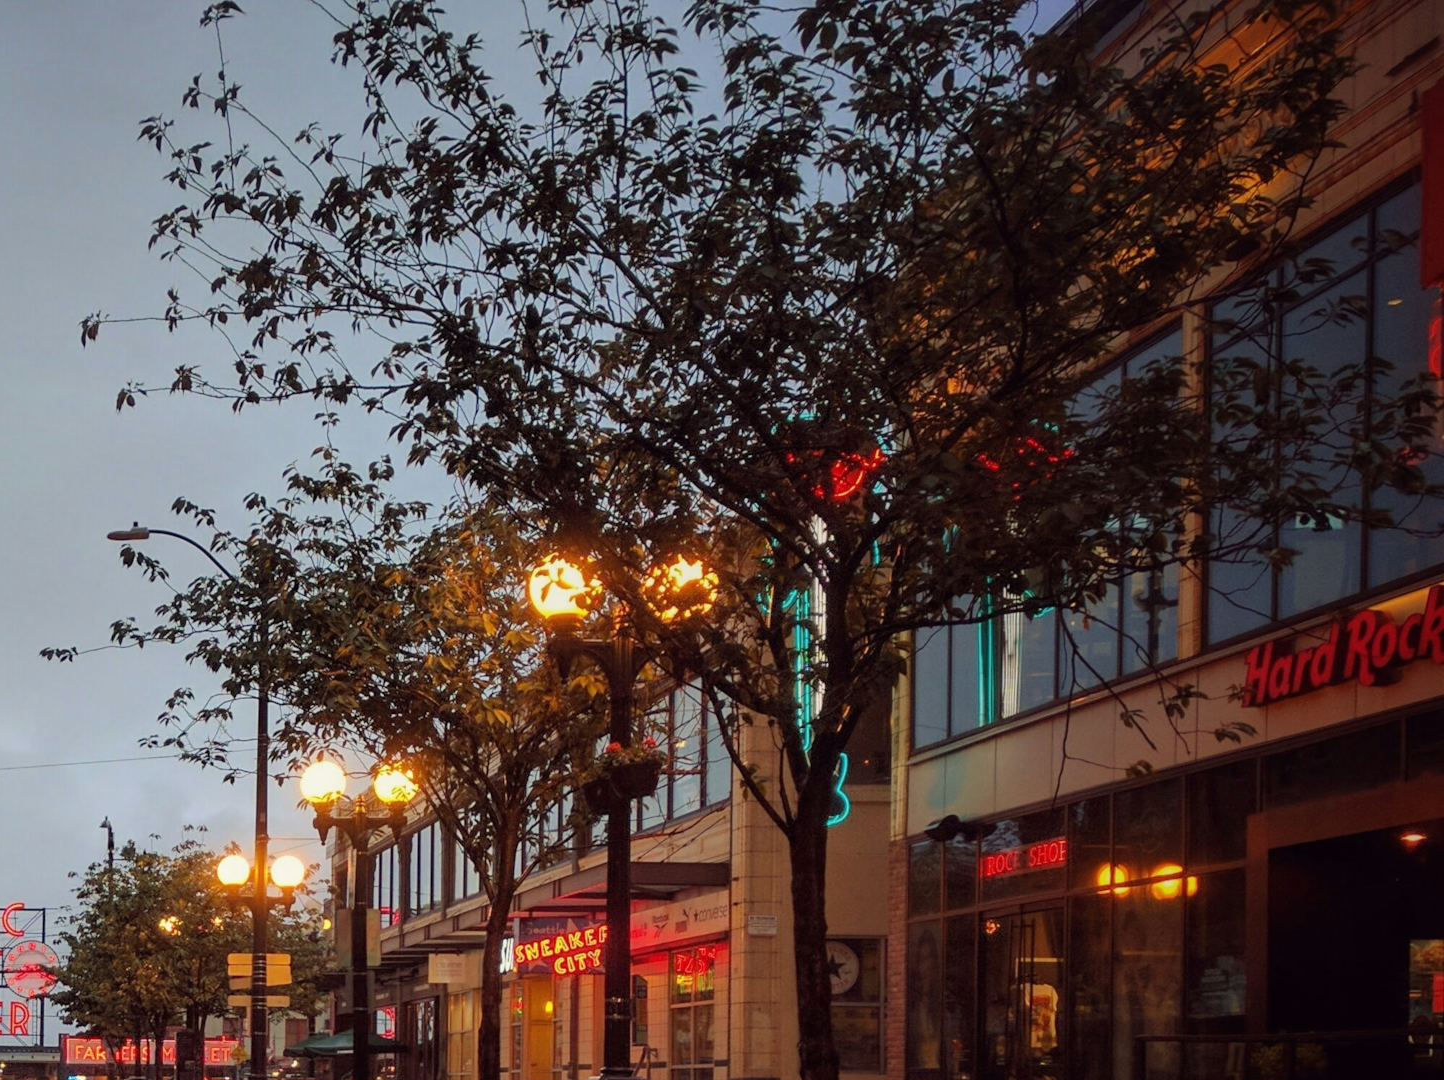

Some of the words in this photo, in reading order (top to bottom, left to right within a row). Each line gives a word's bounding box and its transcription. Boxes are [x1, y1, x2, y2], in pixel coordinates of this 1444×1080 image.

[1241, 621, 1340, 708] Hard
[1343, 584, 1444, 687] Rock
[699, 904, 728, 922] converse
[554, 949, 601, 975] CITY
